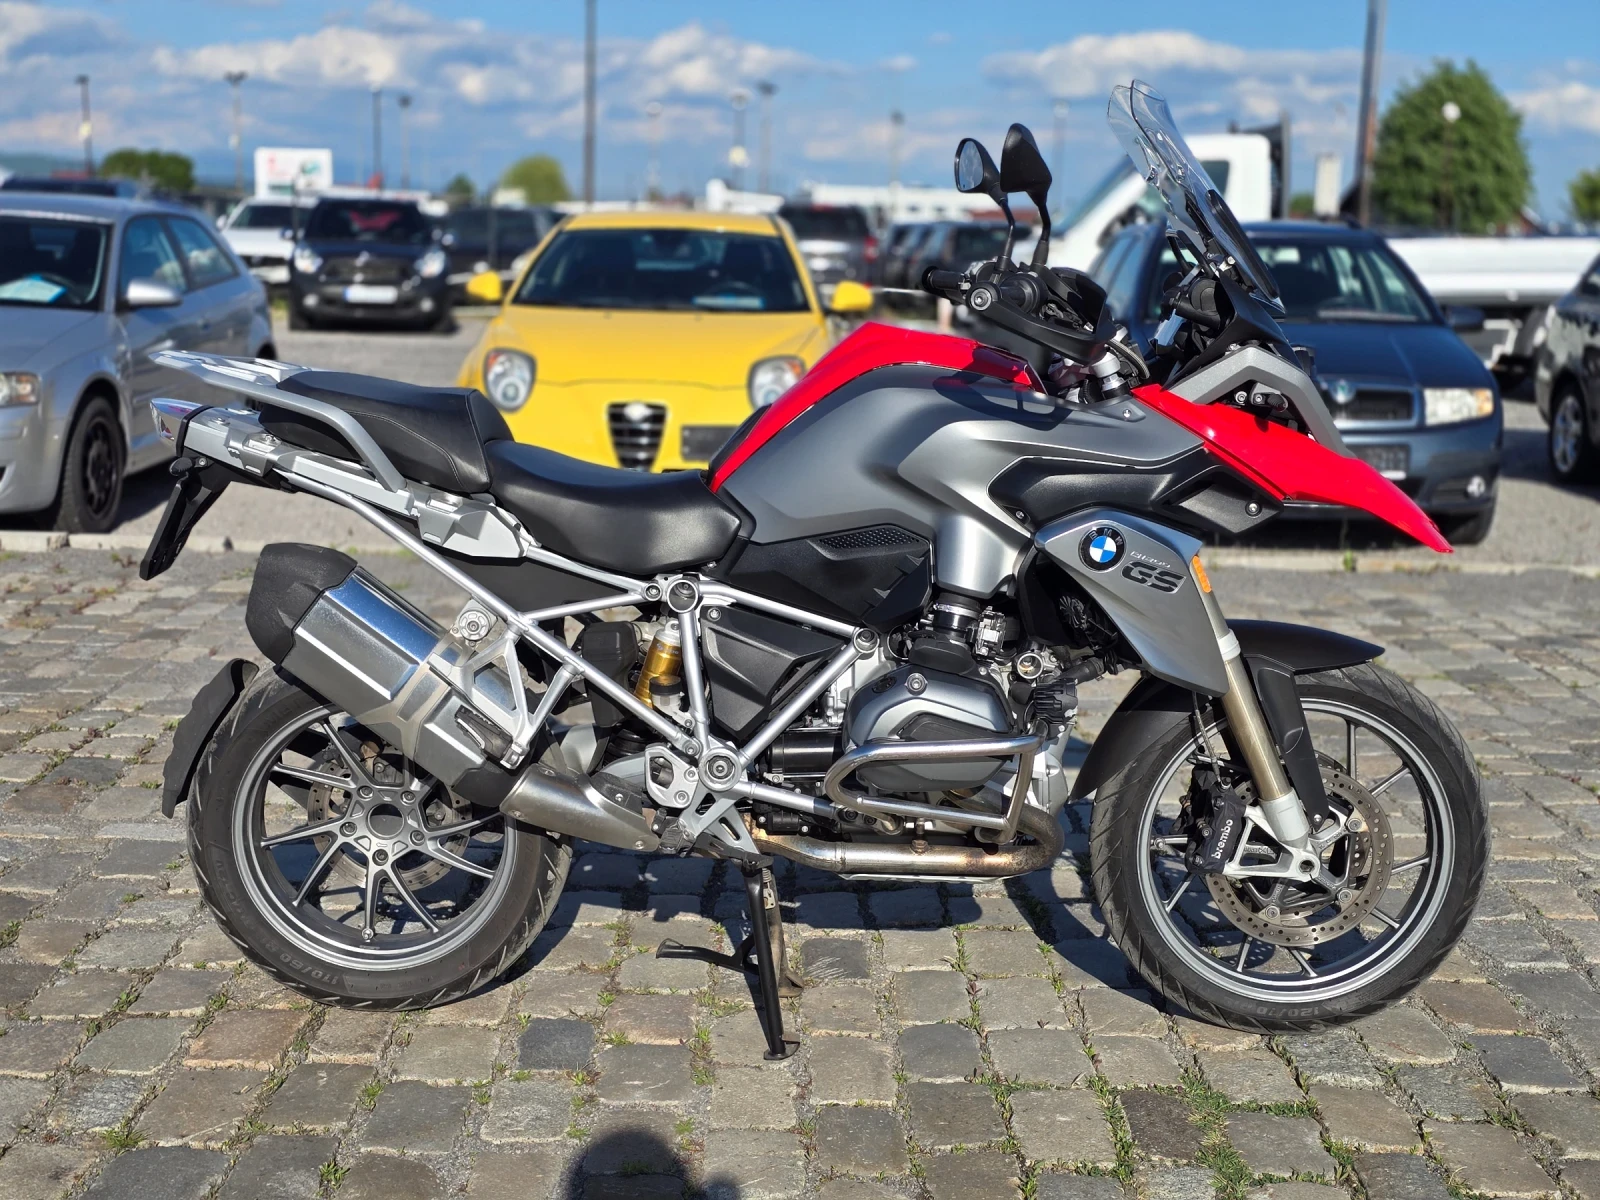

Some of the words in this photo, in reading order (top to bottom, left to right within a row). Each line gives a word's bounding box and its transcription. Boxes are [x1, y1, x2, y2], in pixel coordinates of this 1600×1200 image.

[1089, 529, 1123, 546] BMW
[1121, 560, 1186, 594] GS
[1211, 819, 1234, 860] brembo
